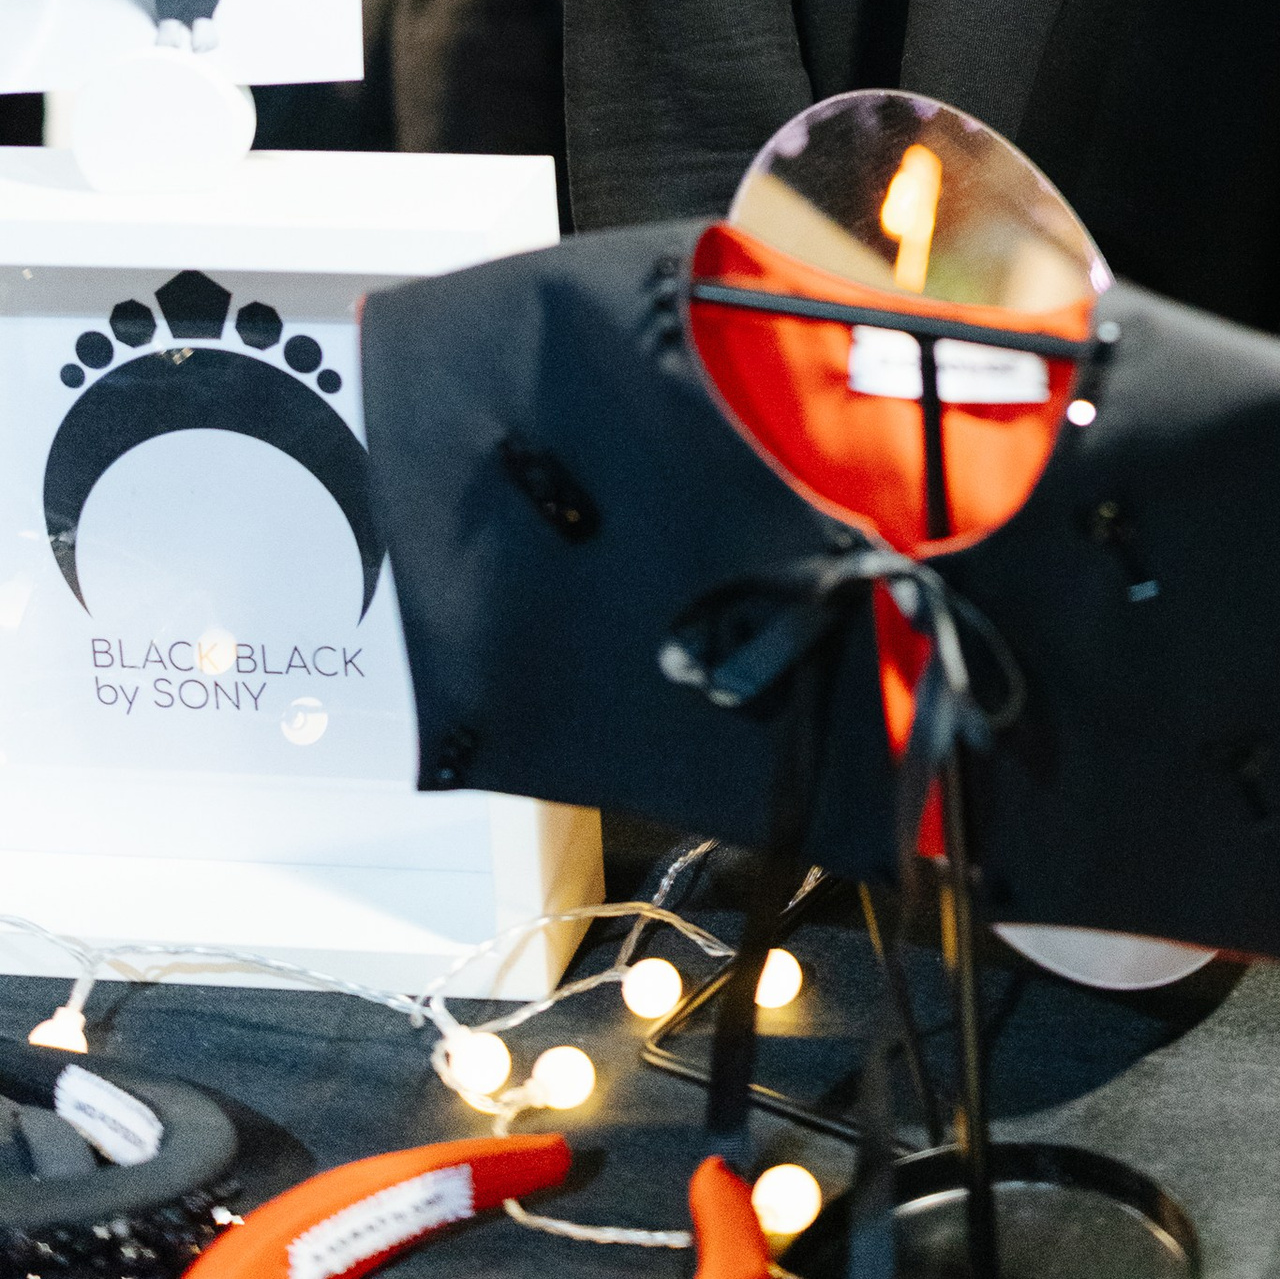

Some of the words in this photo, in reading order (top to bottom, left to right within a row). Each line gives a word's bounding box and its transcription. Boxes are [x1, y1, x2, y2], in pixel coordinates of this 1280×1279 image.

[91, 638, 220, 672] BLACK
[234, 643, 365, 678] BLACK
[95, 675, 139, 715] by
[153, 677, 267, 711] SONY
